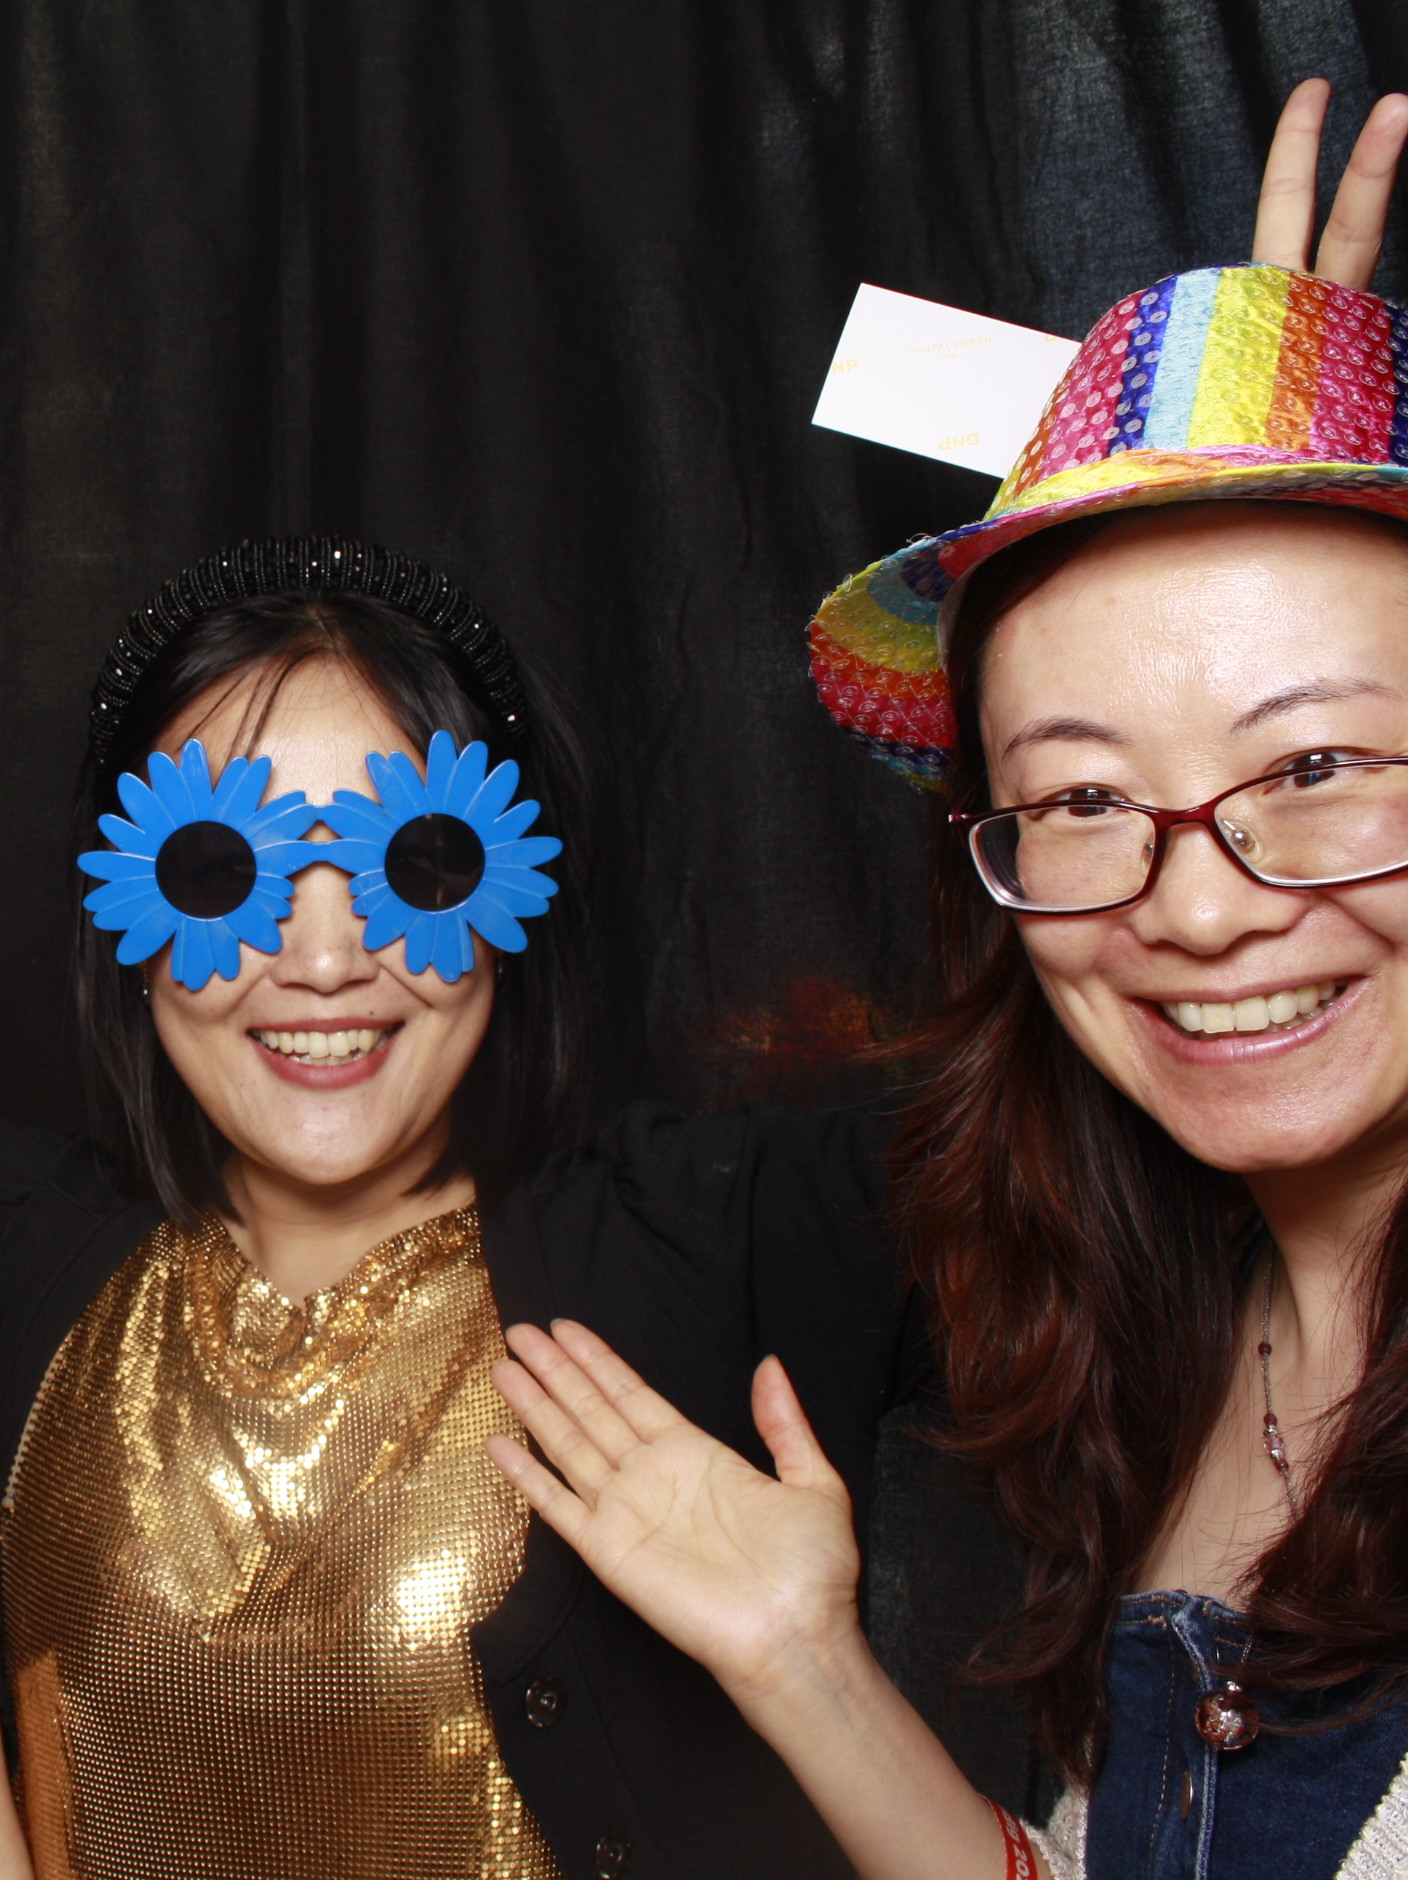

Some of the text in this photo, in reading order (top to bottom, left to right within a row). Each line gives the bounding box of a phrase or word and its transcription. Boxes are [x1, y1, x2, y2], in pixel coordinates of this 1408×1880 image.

[906, 336, 993, 355] DIGITAL PAPER
[937, 432, 980, 450] DNP
